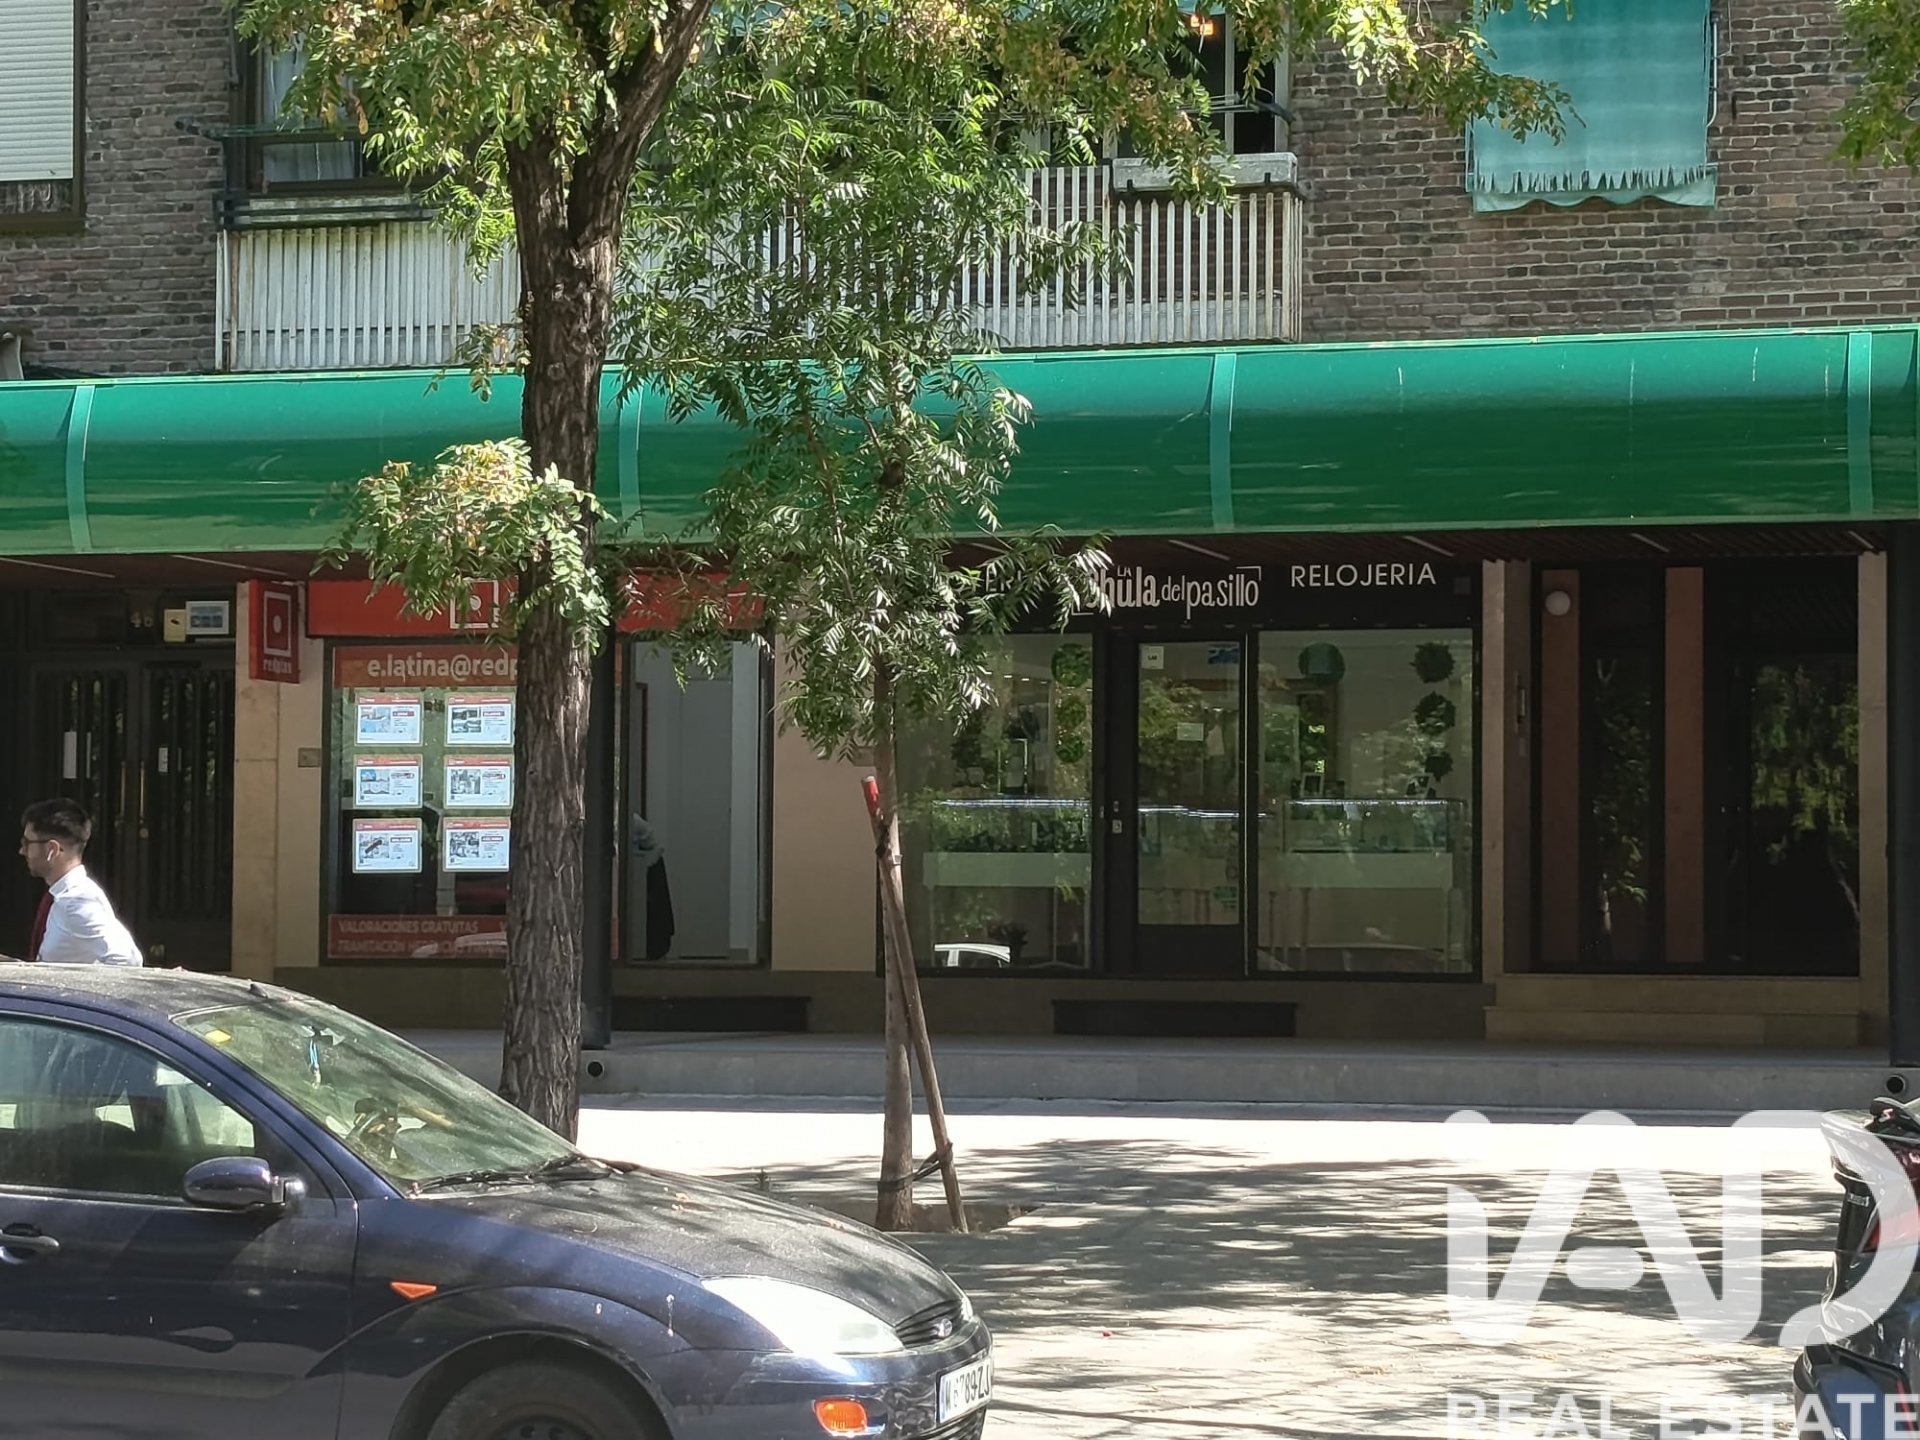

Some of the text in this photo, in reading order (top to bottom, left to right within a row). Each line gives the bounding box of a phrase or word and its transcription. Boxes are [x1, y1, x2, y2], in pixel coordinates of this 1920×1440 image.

[1117, 565, 1132, 577] LA
[1290, 562, 1436, 588] RELOJERIA
[1161, 575, 1185, 601] del
[1186, 573, 1259, 620] pasillo
[338, 920, 479, 933] VALORACIONES GRATUITAS
